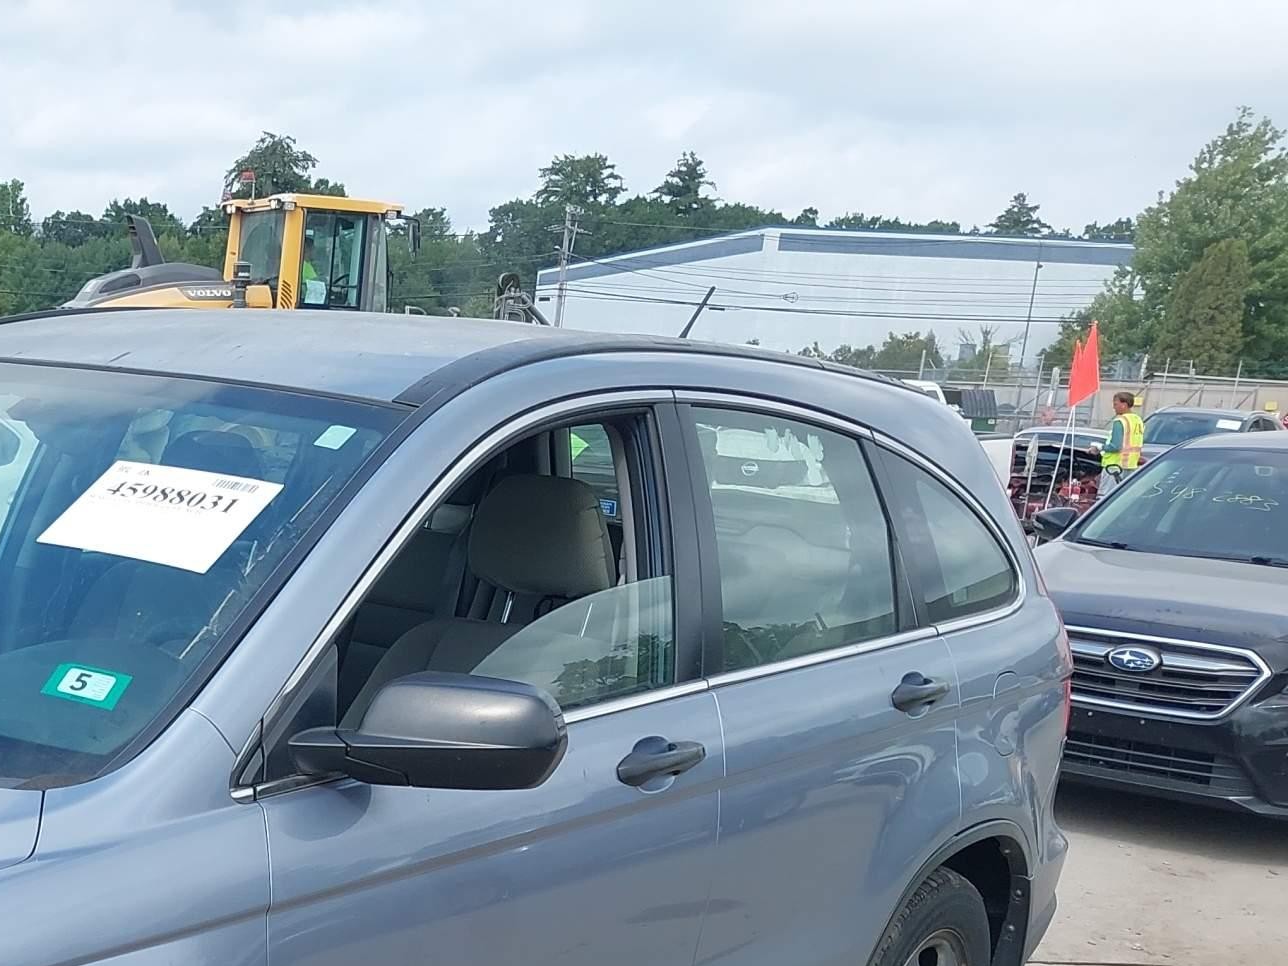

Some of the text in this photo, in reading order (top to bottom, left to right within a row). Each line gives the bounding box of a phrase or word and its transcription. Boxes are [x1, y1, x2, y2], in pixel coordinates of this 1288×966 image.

[187, 289, 232, 297] VOLVO
[106, 481, 240, 513] 45988031
[69, 672, 93, 691] 5
